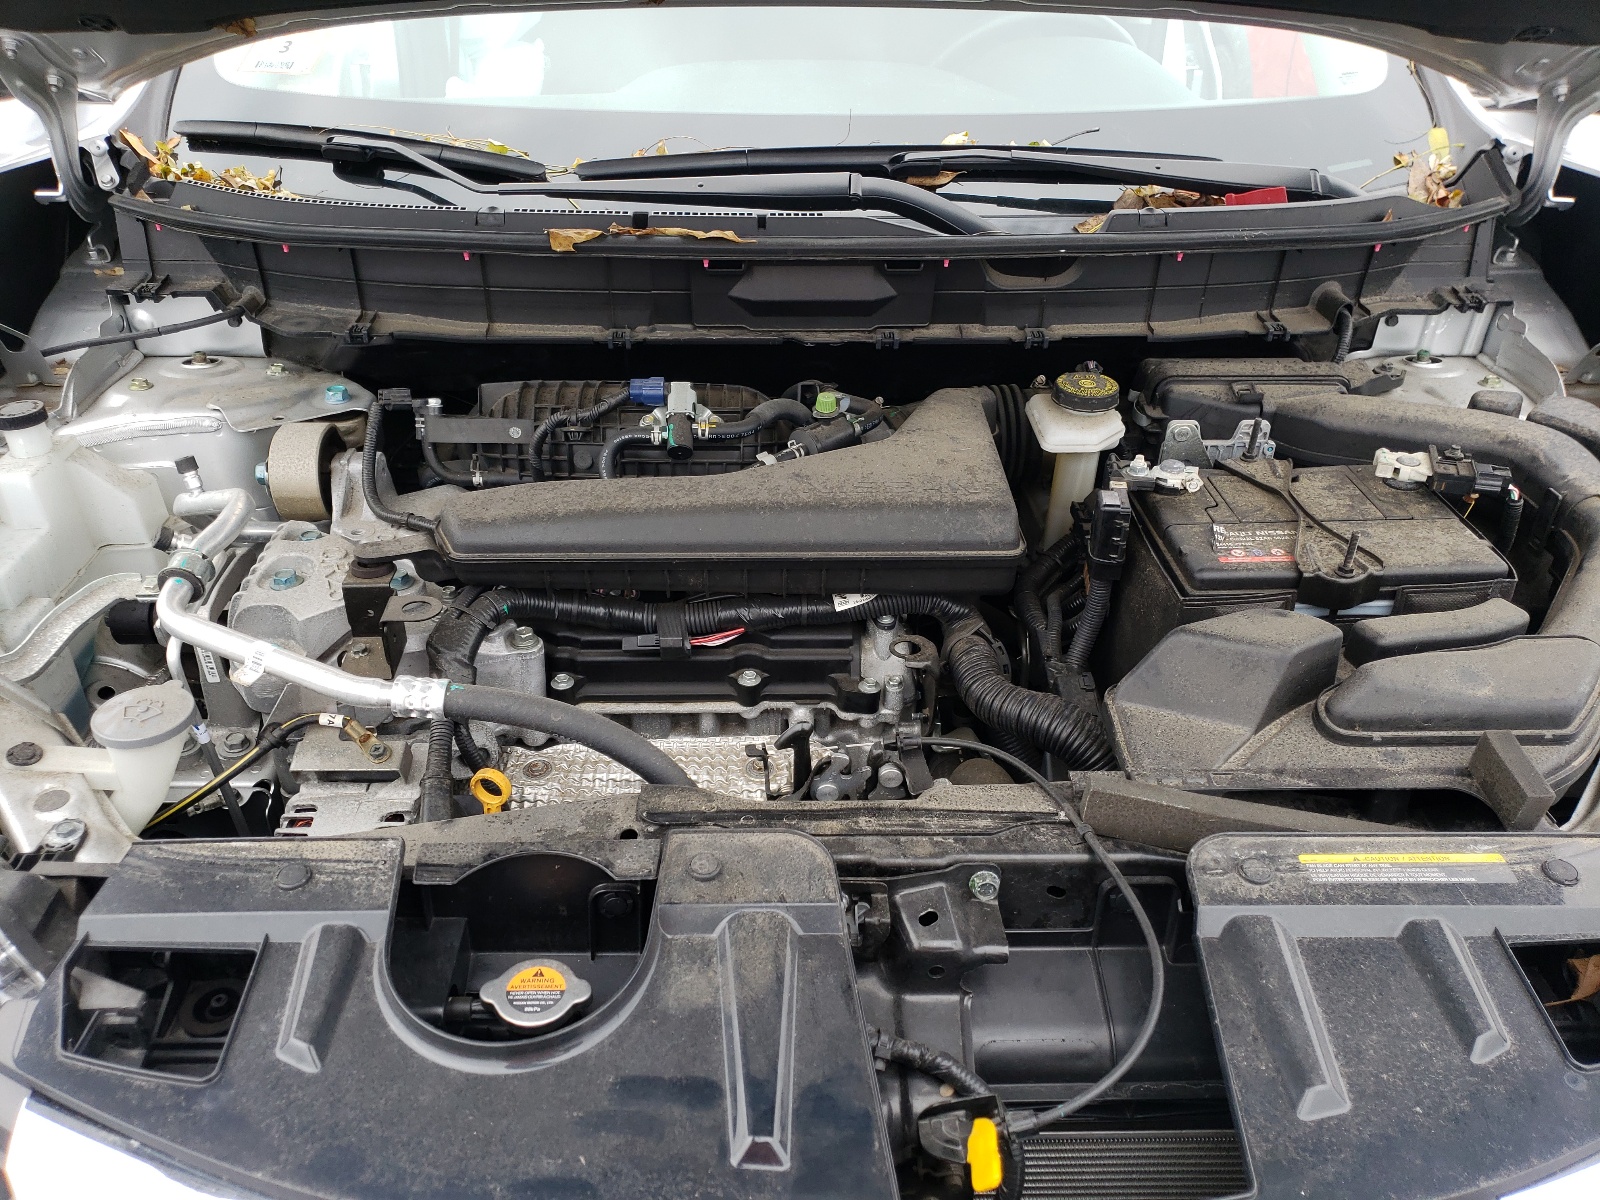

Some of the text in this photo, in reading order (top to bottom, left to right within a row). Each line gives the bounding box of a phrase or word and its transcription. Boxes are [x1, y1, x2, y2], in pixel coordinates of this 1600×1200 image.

[278, 40, 293, 54] 3
[1213, 525, 1253, 537] REAULT
[327, 714, 337, 725] 7A
